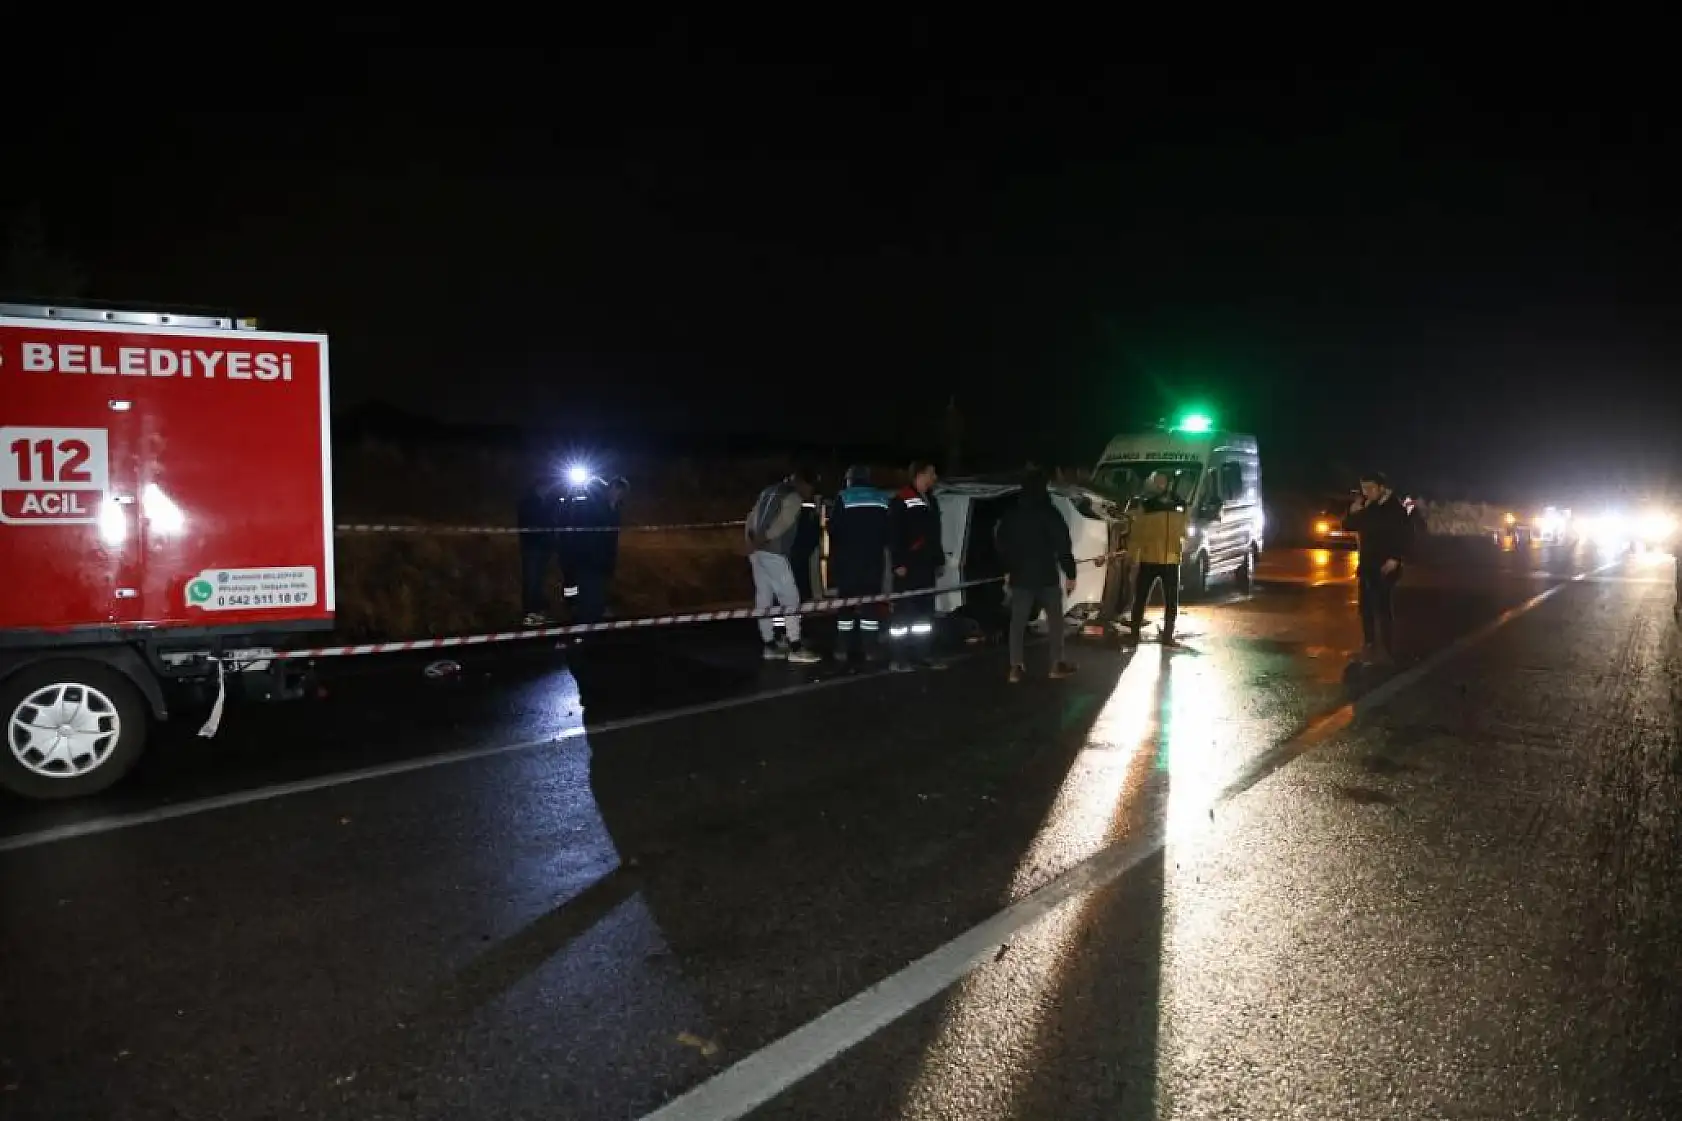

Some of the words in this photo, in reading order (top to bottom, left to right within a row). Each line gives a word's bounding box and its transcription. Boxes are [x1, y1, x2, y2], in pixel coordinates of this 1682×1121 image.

[10, 438, 92, 482] 112
[218, 595, 225, 606] 0
[228, 594, 250, 605] 542
[254, 593, 273, 604] 511
